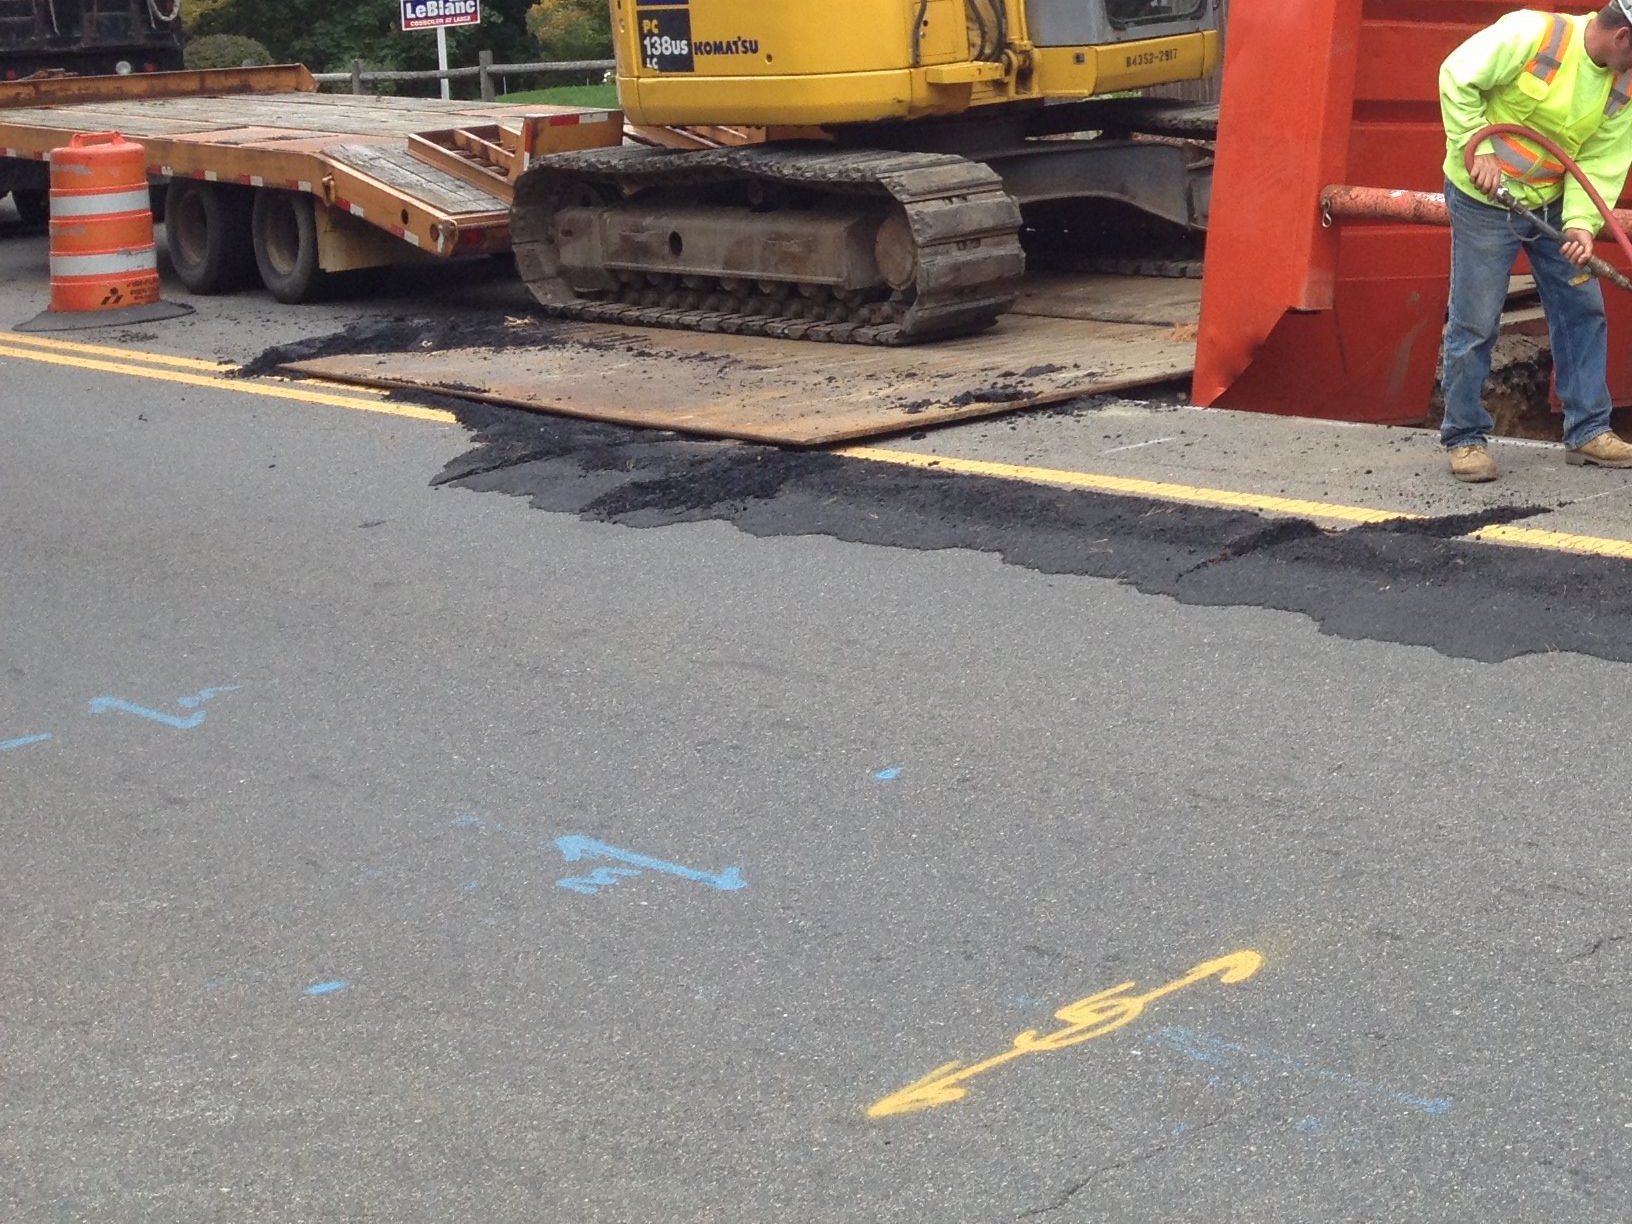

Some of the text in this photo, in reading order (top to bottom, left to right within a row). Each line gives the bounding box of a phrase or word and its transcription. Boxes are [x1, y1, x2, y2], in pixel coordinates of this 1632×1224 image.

[405, 0, 476, 19] LeBlanc
[642, 19, 659, 34] PC
[693, 35, 759, 55] KOMATSU
